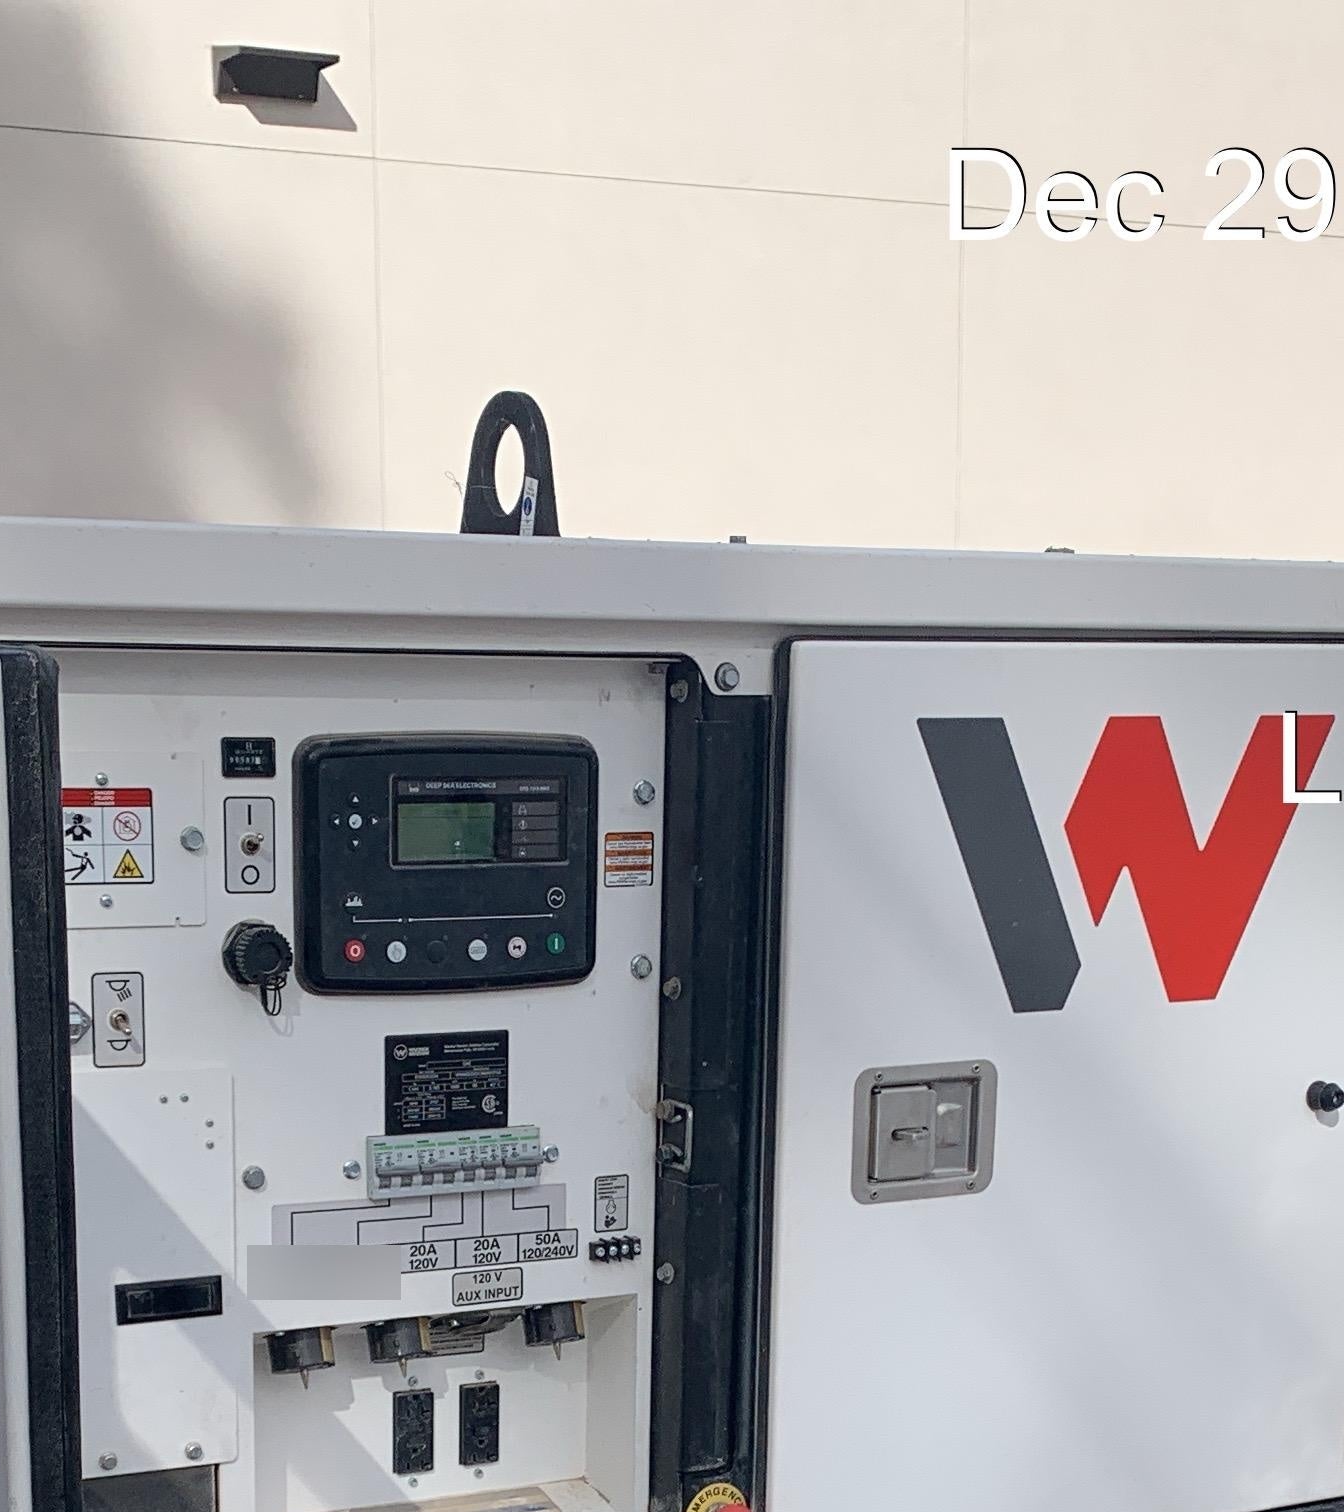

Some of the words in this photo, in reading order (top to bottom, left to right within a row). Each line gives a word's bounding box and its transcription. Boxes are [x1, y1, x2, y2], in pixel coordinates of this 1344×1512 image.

[455, 781, 496, 789] ELECTRONICS
[473, 1238, 501, 1252] 20A
[535, 1232, 561, 1246] 50A
[409, 1243, 437, 1257] 20A
[521, 1245, 574, 1260] 120/240V
[408, 1257, 439, 1271] 120V
[472, 1251, 502, 1265] 120V
[472, 1272, 492, 1284] 120
[494, 1271, 503, 1283] V
[456, 1290, 481, 1303] AUX
[484, 1286, 520, 1300] INPUT
